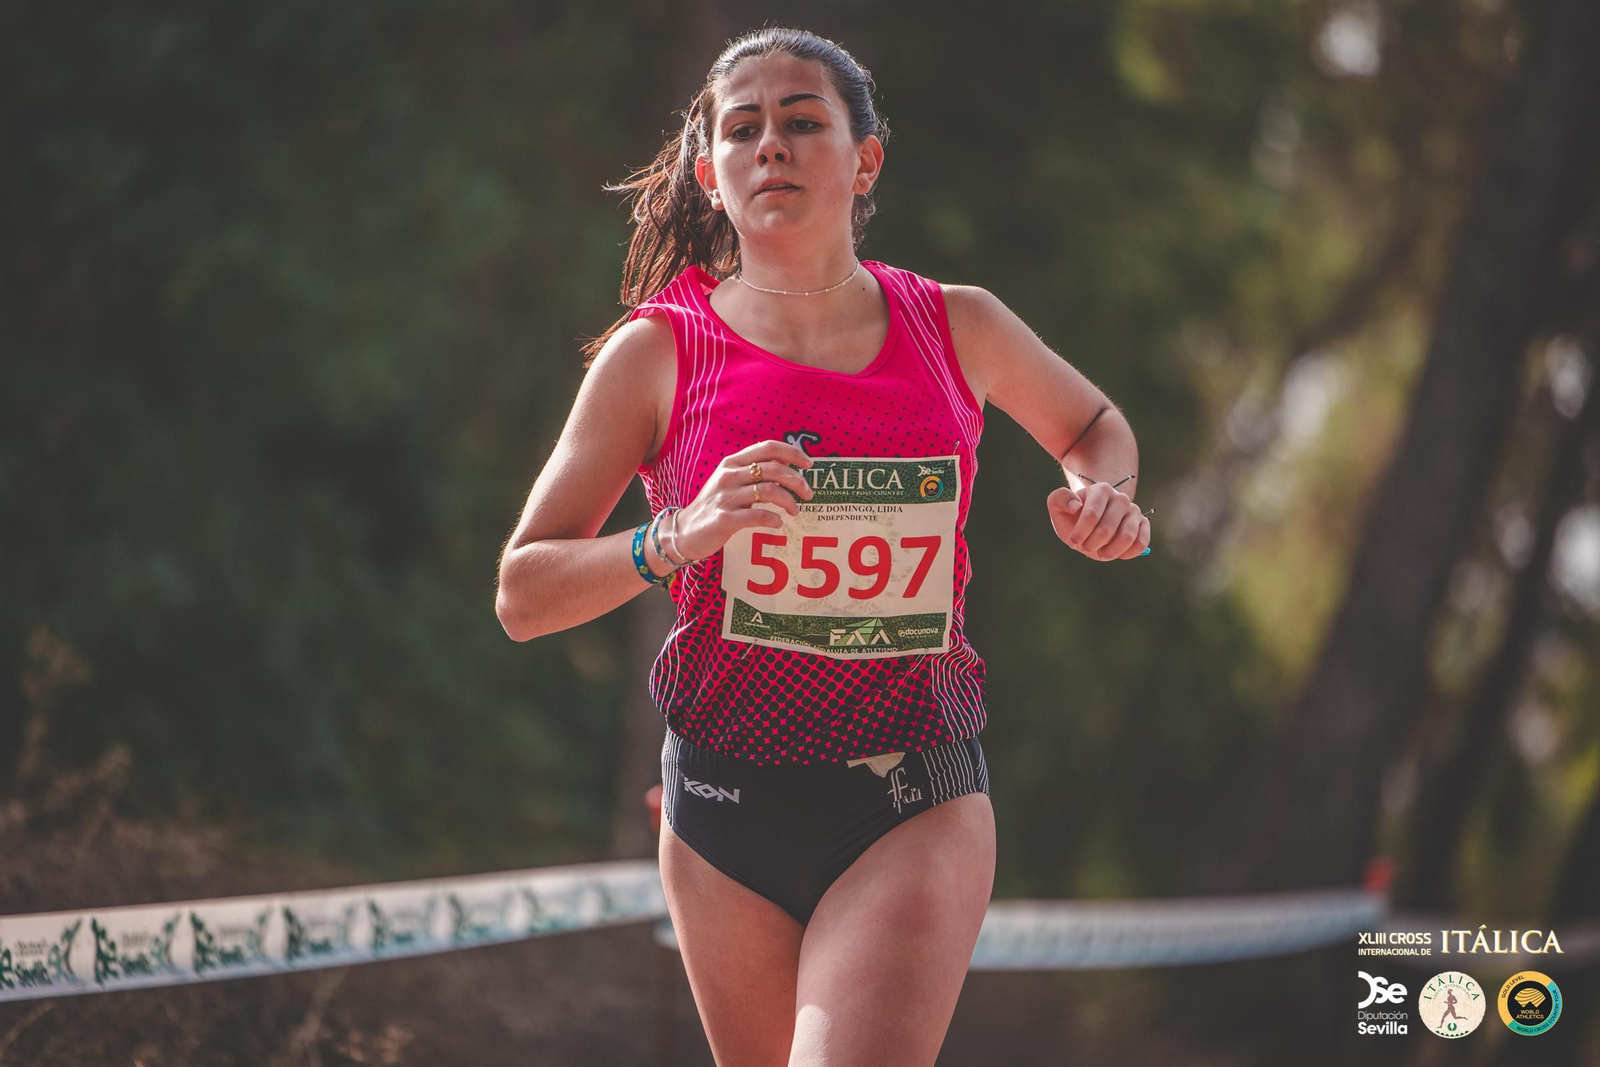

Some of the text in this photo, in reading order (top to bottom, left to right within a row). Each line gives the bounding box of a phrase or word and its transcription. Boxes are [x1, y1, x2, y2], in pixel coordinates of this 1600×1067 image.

[798, 463, 904, 490] ITÁLICA
[797, 503, 903, 514] ÉREZ DOMINGO, LIDIA
[746, 532, 942, 600] 5597
[905, 627, 939, 636] docunova
